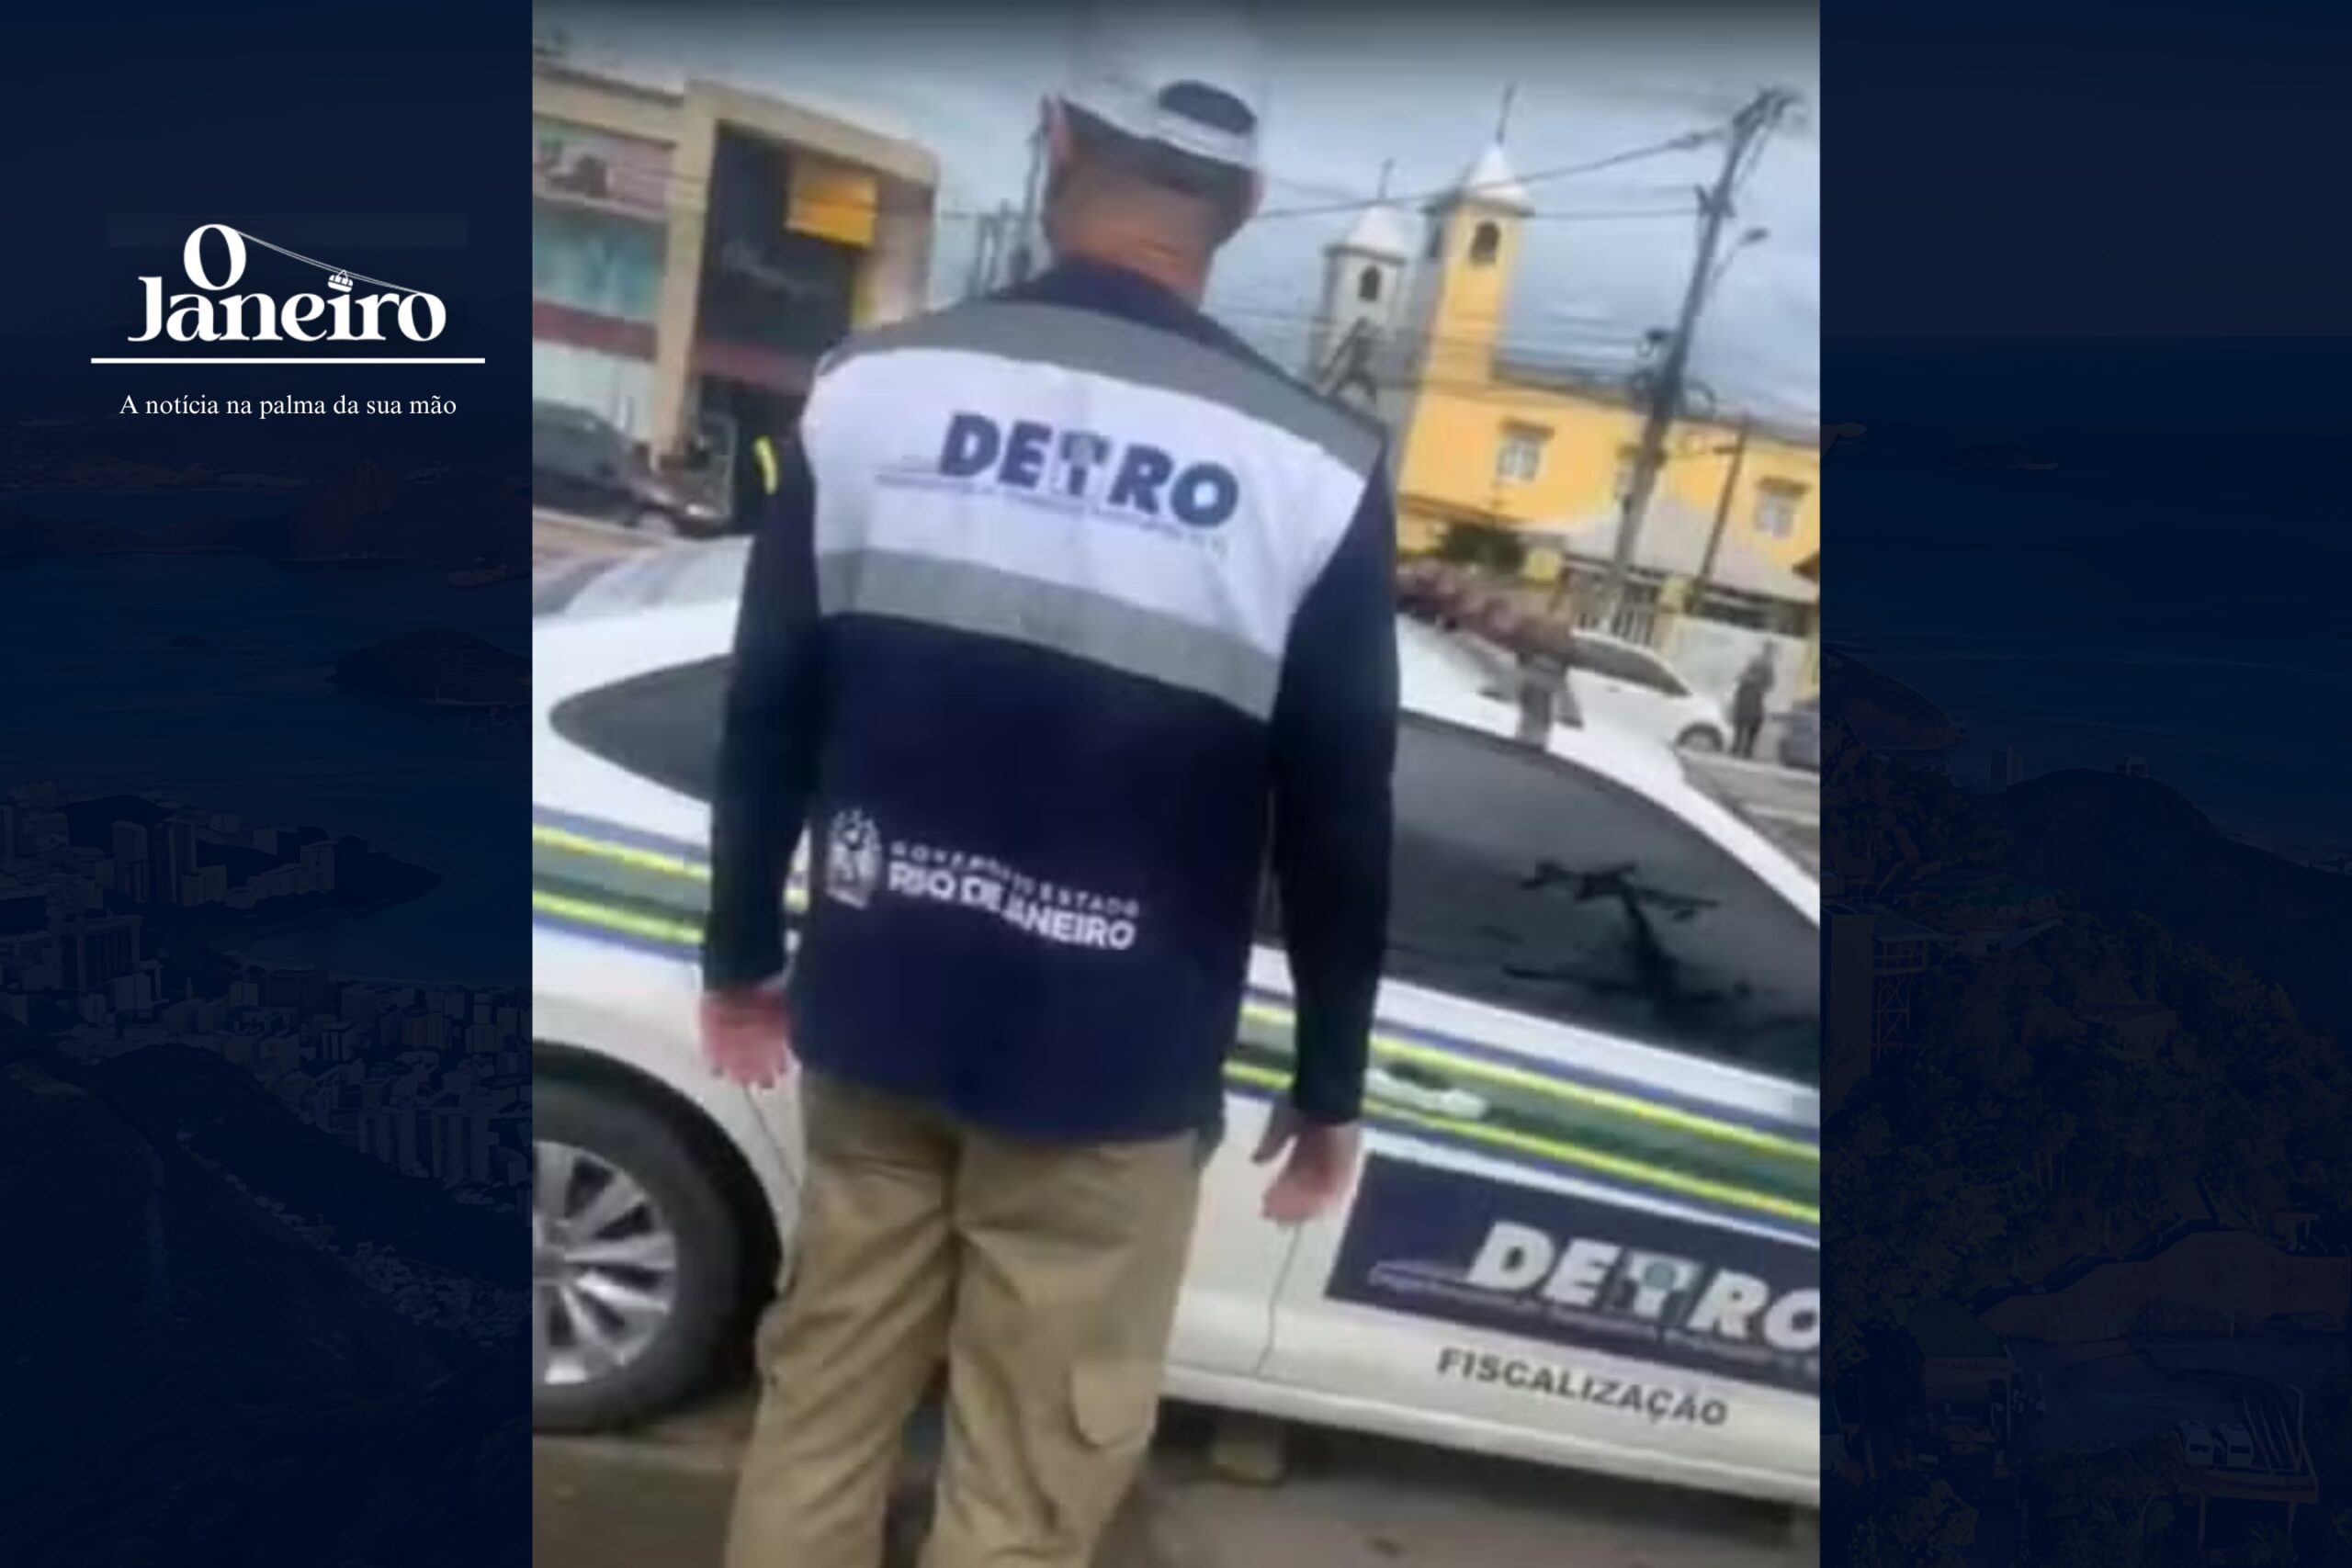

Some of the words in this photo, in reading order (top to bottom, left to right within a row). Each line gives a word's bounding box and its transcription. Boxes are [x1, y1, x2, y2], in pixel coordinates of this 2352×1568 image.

[937, 412, 1239, 528] DETRO
[888, 859, 956, 901] RIO
[1469, 1221, 1820, 1351] DETRO
